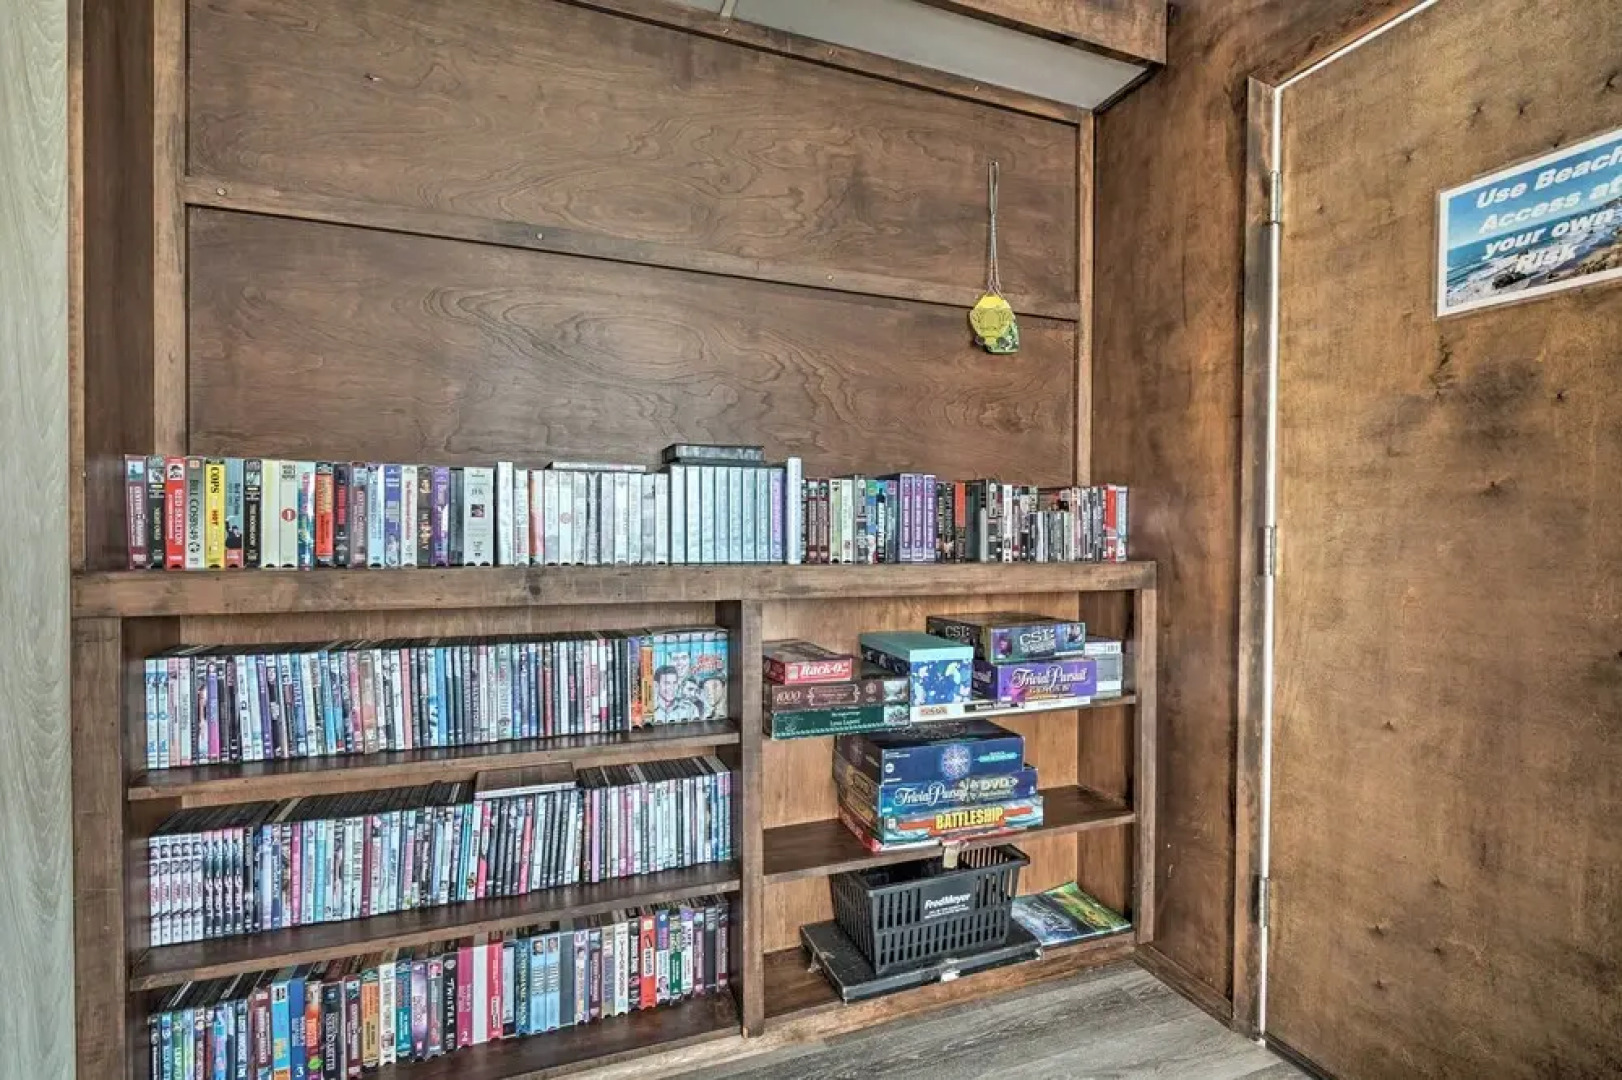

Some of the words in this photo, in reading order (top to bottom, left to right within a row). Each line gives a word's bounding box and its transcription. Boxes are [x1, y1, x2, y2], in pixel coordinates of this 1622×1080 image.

[1476, 182, 1528, 209] Use
[1478, 191, 1582, 236] Access
[1482, 228, 1547, 261] your
[1551, 208, 1615, 238] own
[210, 466, 220, 494] COPS
[945, 625, 971, 638] CSI:
[1011, 667, 1050, 689] Trivial
[1047, 664, 1088, 691] Pursuit
[894, 787, 932, 807] Trivial
[935, 806, 1004, 831] BATTLESHIP
[446, 978, 455, 1026] TWISTER
